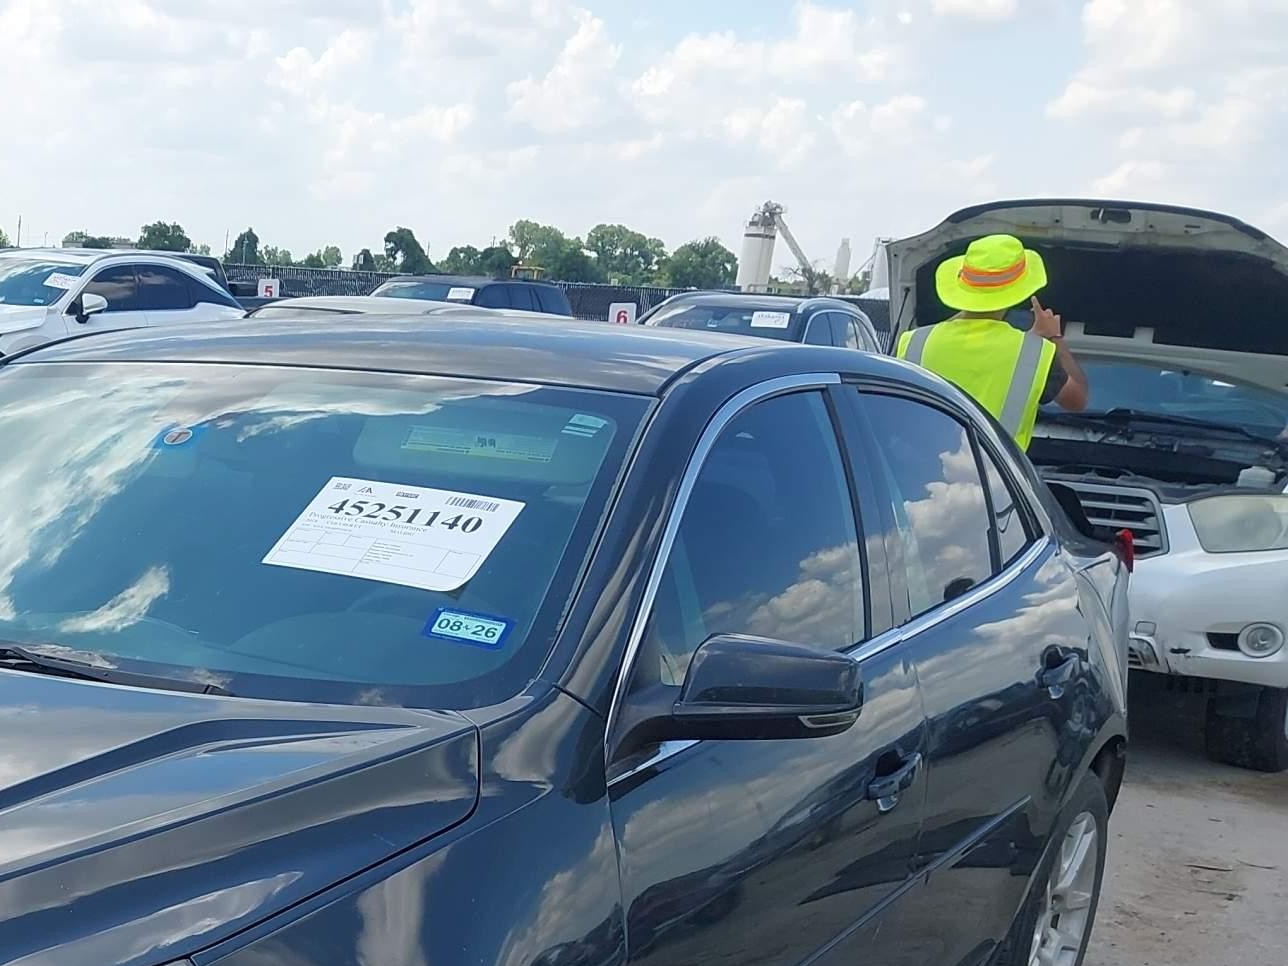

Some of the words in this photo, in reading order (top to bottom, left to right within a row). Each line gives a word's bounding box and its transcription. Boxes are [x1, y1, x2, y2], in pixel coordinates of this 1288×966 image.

[264, 286, 273, 297] 5
[616, 310, 627, 324] 6
[327, 498, 484, 534] 45251140
[437, 618, 464, 632] 08
[471, 624, 498, 639] 26
